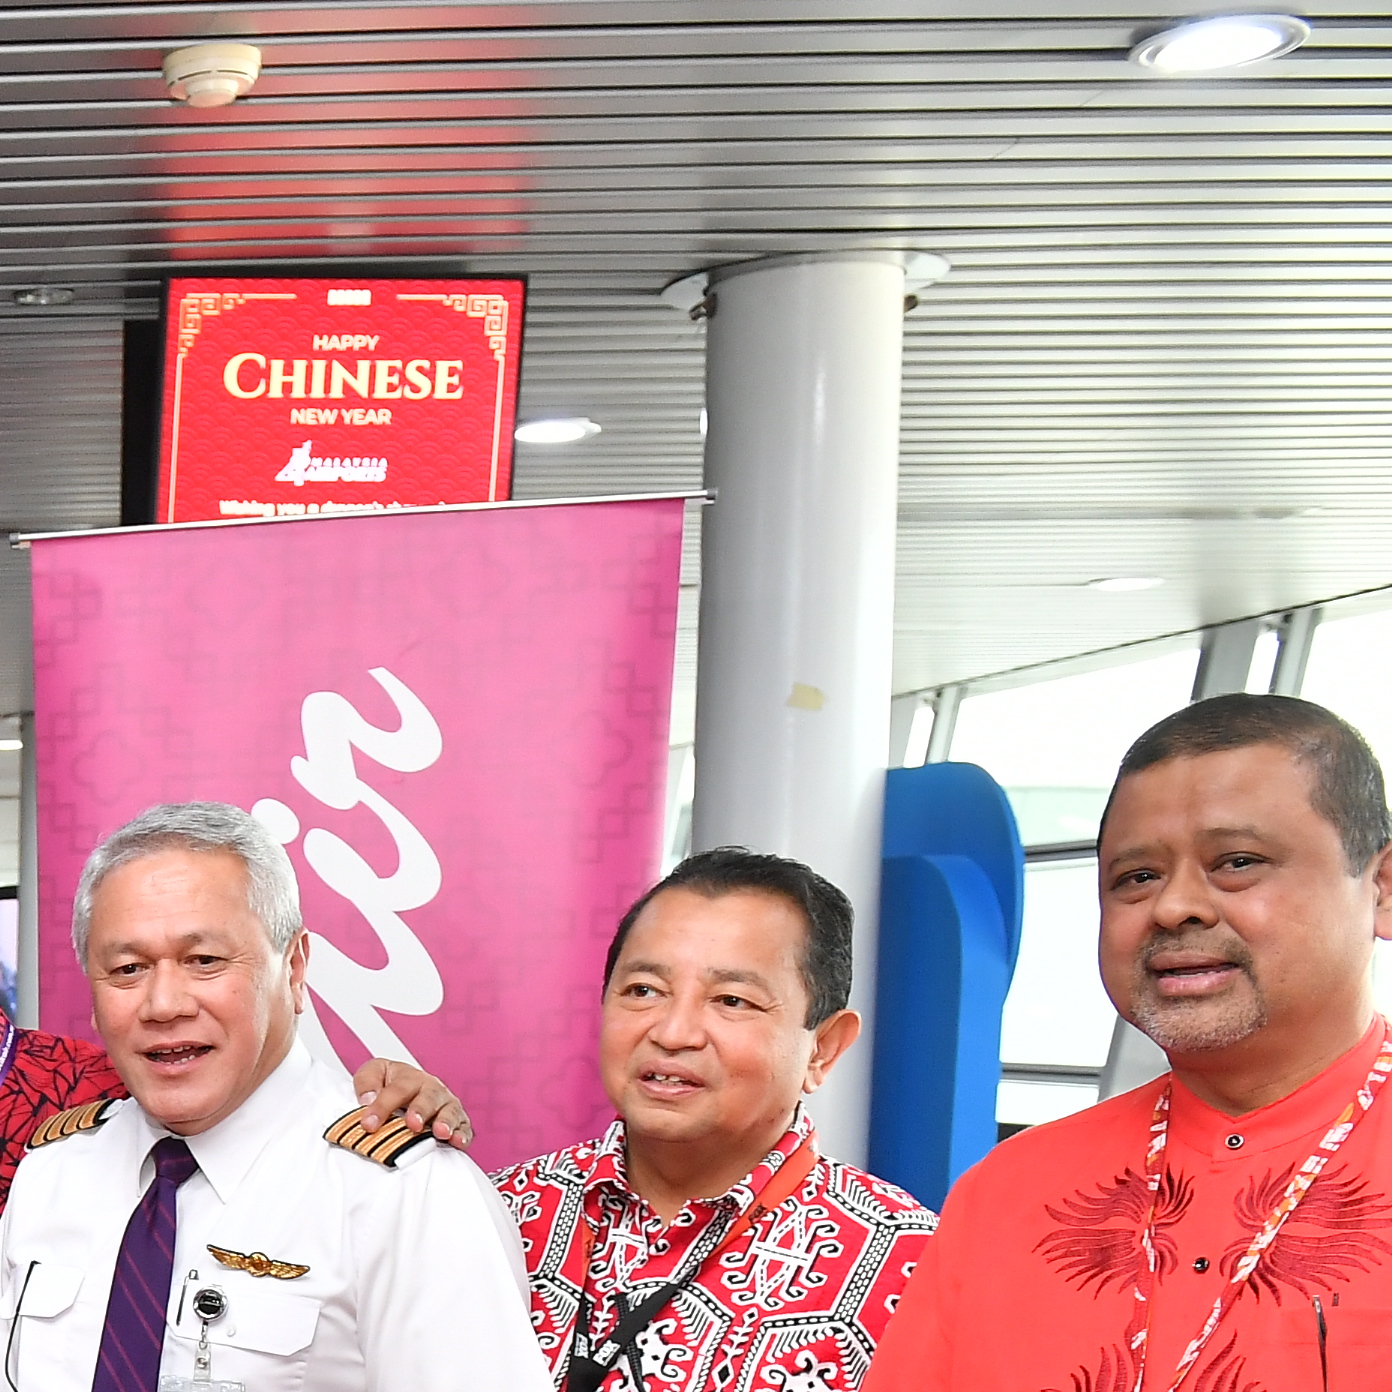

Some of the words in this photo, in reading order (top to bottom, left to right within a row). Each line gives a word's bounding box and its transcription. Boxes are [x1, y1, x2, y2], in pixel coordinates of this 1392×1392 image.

[313, 335, 379, 351] HAPPY
[223, 353, 464, 400] CHINESE
[291, 408, 339, 425] NEW
[341, 408, 392, 425] YEAR
